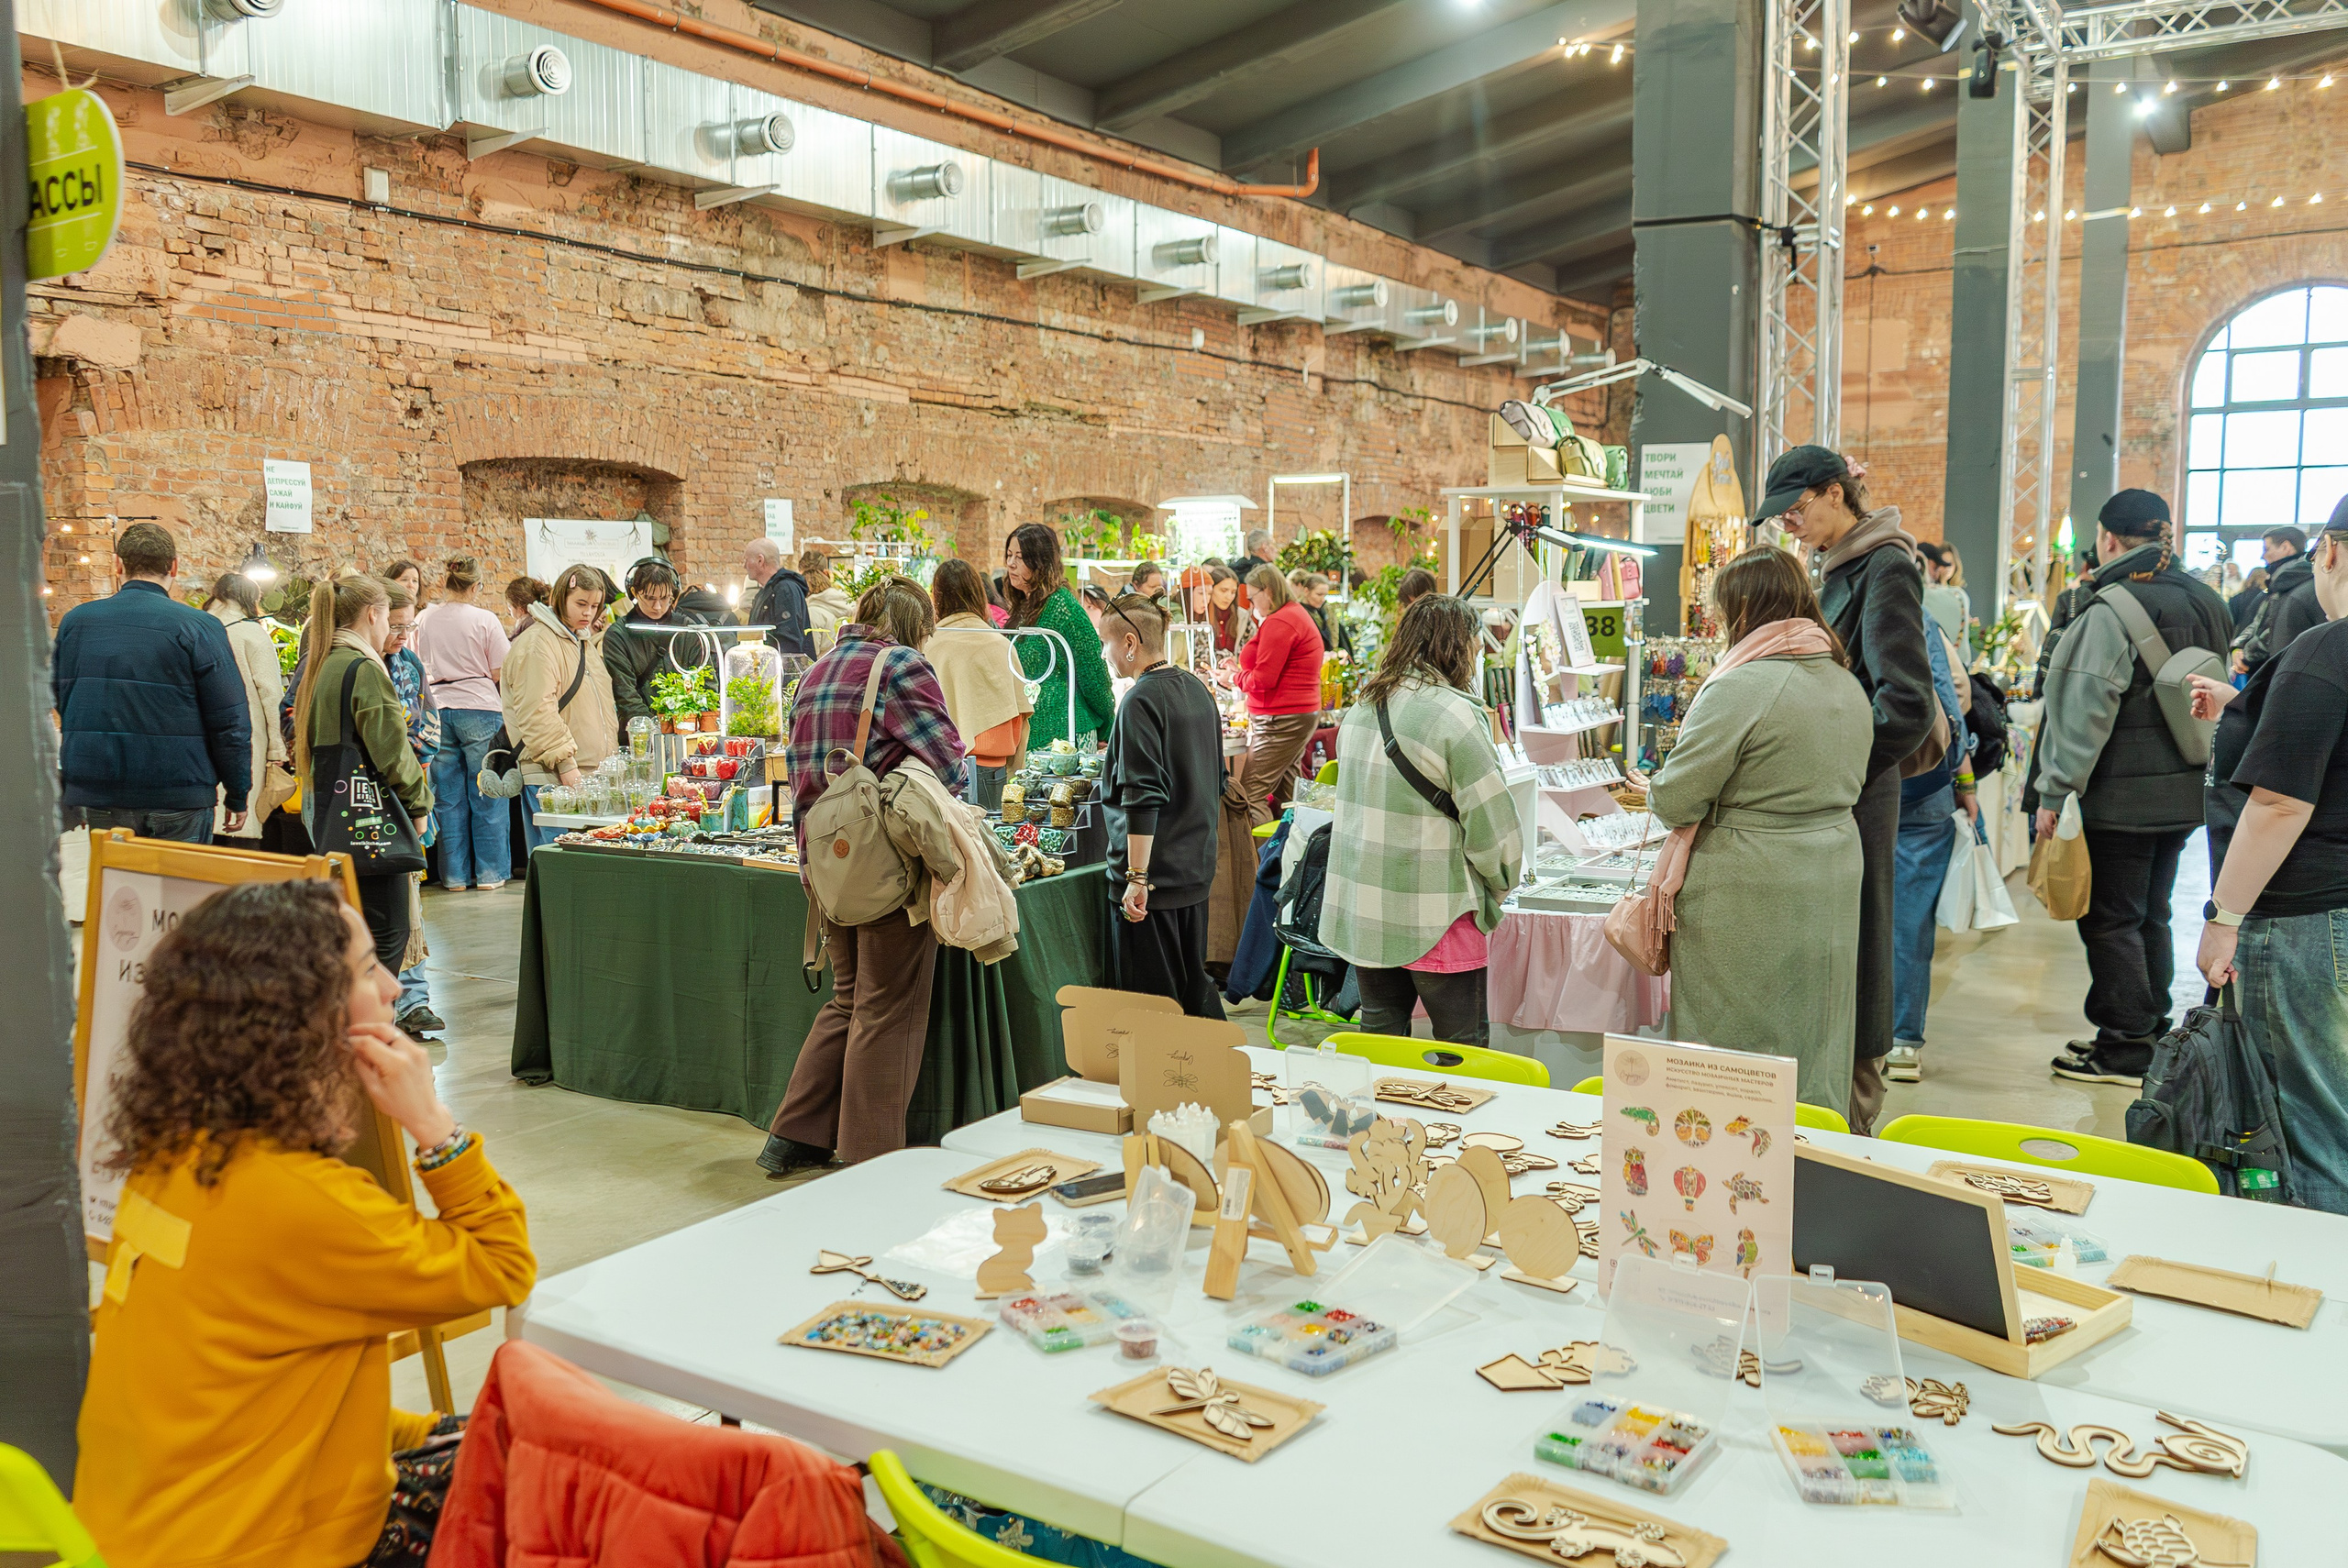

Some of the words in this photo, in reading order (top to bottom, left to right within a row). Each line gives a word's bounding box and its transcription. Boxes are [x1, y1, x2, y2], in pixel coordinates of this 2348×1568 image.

[1645, 453, 1677, 463] ТВОРИ
[1645, 468, 1684, 479] МЕЧТАЙ
[267, 477, 306, 487] ДЕПРЕССУЙ
[269, 489, 293, 497] САЖАЙ
[275, 501, 303, 510] КАЙФУЙ
[1644, 503, 1675, 513] ЦВЕТИ
[1586, 615, 1616, 637] 38
[1667, 1057, 1706, 1069] МОЗАИКА
[1707, 1063, 1718, 1071] ИЗ
[1720, 1066, 1777, 1079] САМОЦВЕТОВ
[1666, 1066, 1700, 1076] ИСКУССТВО
[1701, 1072, 1739, 1082] МОЗАИЧНЫХ
[1741, 1077, 1774, 1088] МАСТЕРОВ
